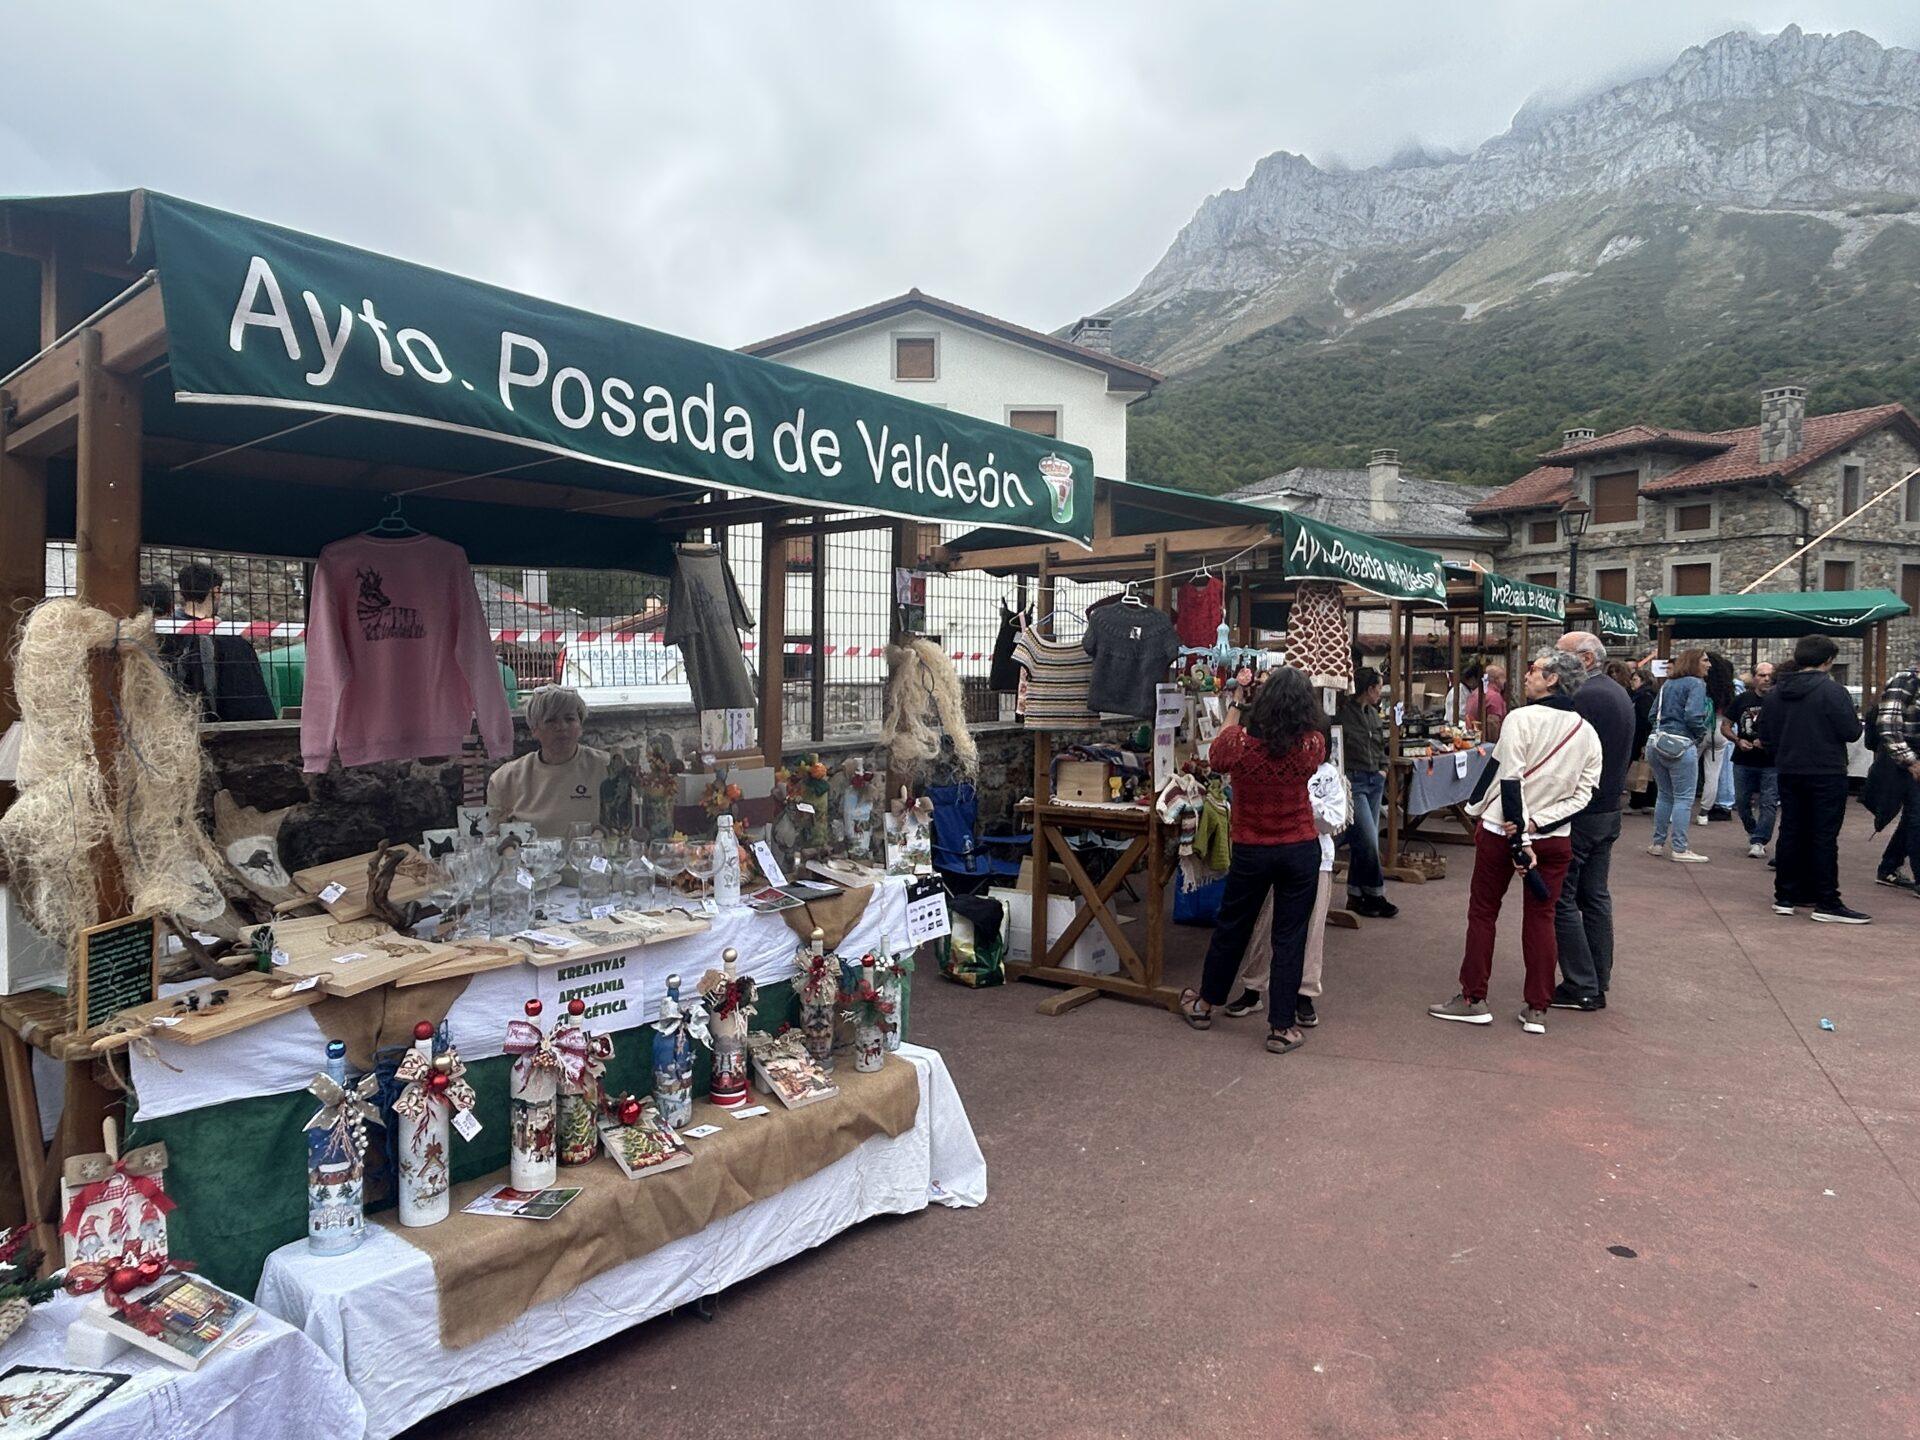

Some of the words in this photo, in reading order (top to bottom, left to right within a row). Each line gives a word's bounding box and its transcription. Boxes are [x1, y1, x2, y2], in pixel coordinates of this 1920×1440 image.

[229, 255, 475, 391] Ayto.
[498, 330, 755, 462] Posada
[772, 408, 843, 478] de
[856, 418, 1034, 509] Valdeón
[557, 956, 626, 981] KREATIVAS
